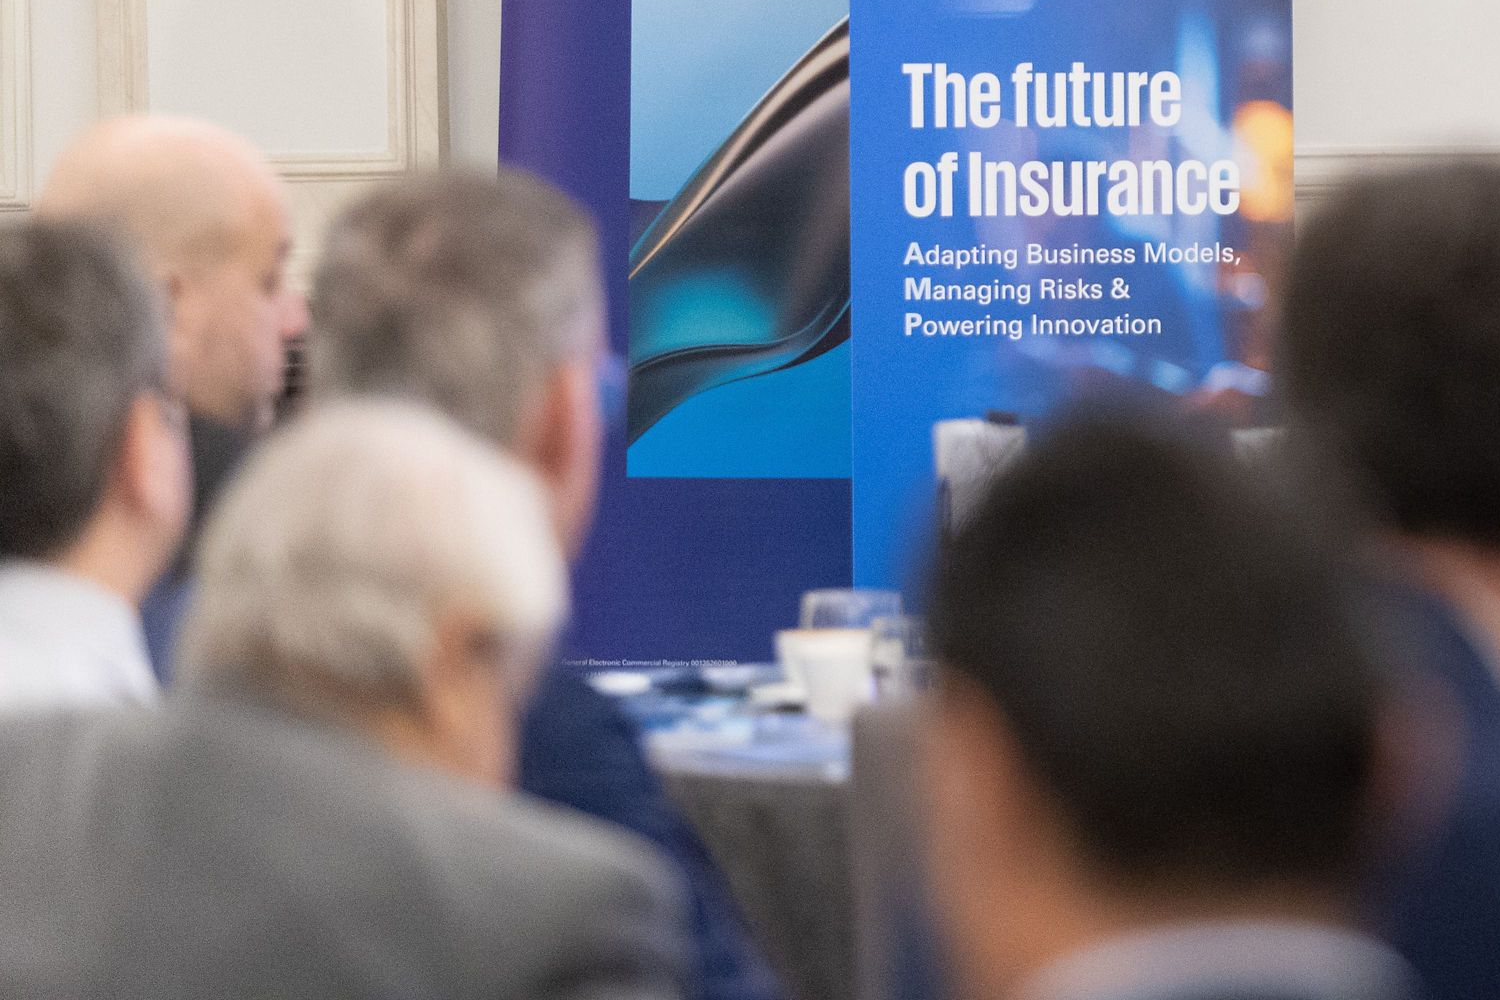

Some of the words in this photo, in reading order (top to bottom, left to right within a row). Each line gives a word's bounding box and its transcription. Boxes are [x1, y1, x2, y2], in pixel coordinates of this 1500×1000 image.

[902, 62, 1001, 129] The
[1012, 61, 1182, 128] future
[903, 151, 959, 218] of
[968, 151, 1240, 218] Insurance
[903, 242, 1018, 270] Adapting
[1026, 242, 1136, 264] Business
[1144, 240, 1242, 267] Models,
[904, 277, 1032, 305] Managing
[1039, 278, 1103, 300] Risks
[1110, 277, 1131, 300] &
[904, 312, 1024, 341] Powering
[1031, 313, 1162, 336] Innovation
[588, 659, 621, 667] Electronic
[622, 659, 661, 667] Commercial
[662, 659, 690, 669] Registry
